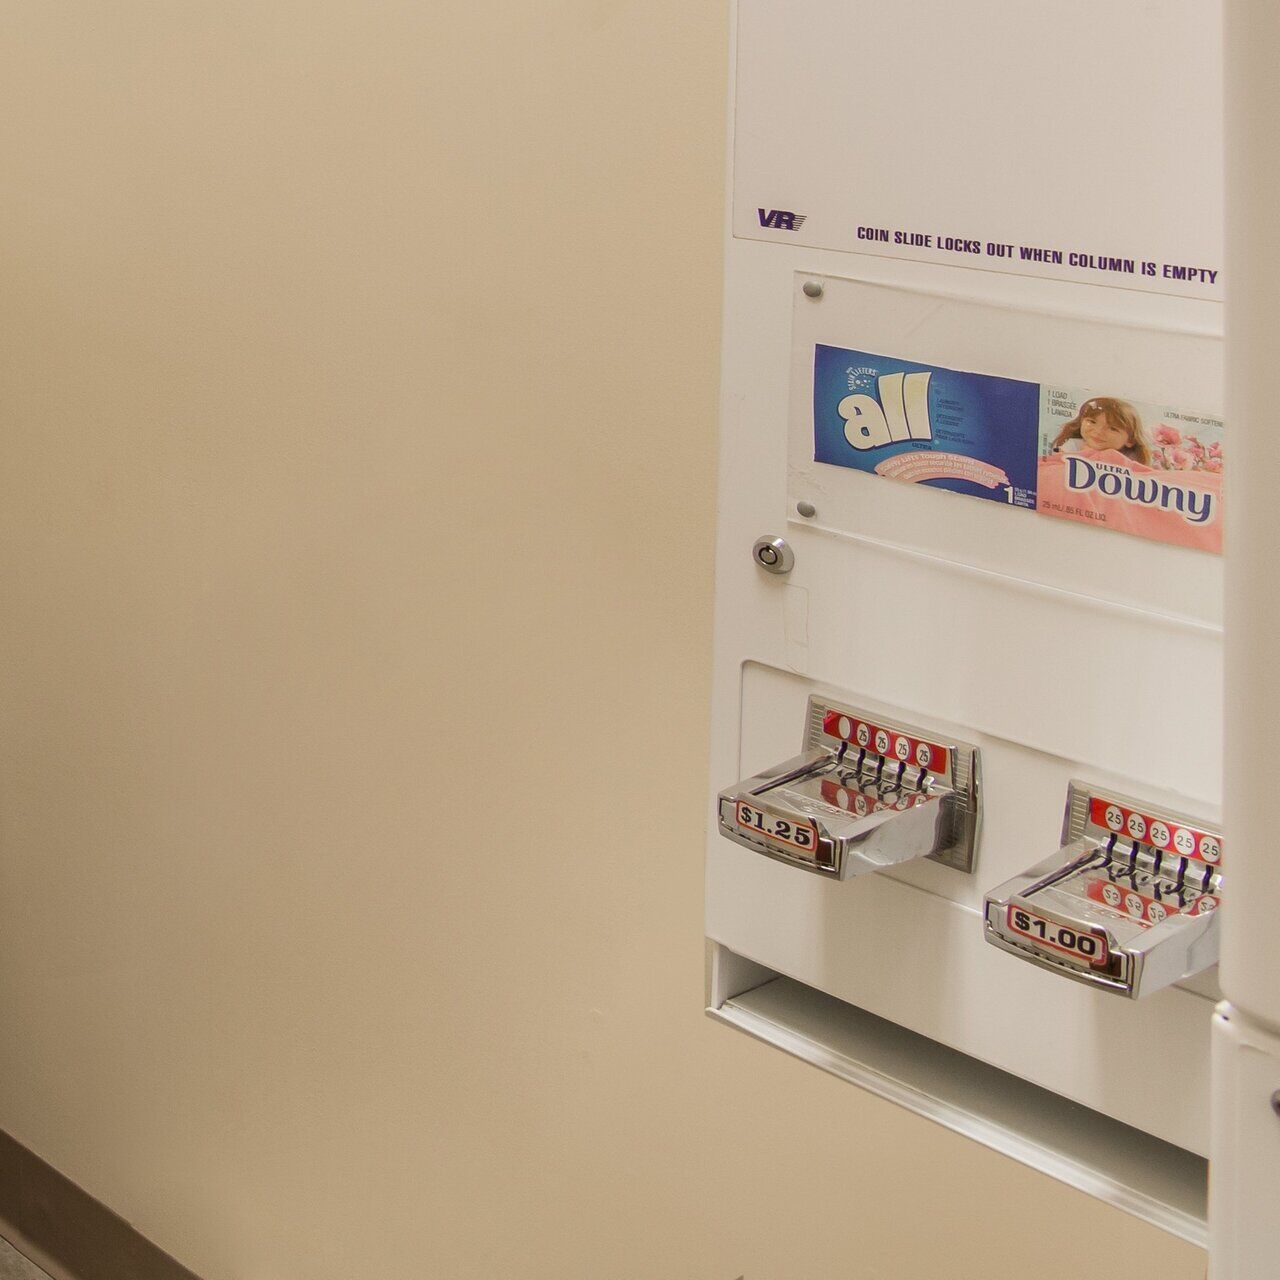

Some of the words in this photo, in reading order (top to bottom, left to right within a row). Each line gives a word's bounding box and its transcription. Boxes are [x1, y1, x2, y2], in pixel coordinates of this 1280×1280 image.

[857, 226, 889, 242] COIN
[894, 230, 932, 248] SLIDE
[937, 235, 981, 255] LOCKS
[986, 242, 1015, 259] OUT
[1019, 246, 1063, 265] WHEN
[1068, 252, 1136, 275] COLUMN
[1141, 262, 1157, 277] IS
[1163, 265, 1219, 285] EMPTY
[837, 371, 932, 451] all
[1052, 390, 1068, 399] LOAD
[1066, 457, 1212, 522] Downy
[1095, 463, 1131, 476] ULTRA
[1003, 486, 1014, 504] 1
[858, 728, 868, 742] 25
[877, 736, 887, 750] 25
[898, 742, 908, 756] 25
[919, 748, 929, 763] 25
[740, 805, 811, 846] $1.25
[1107, 810, 1122, 826] 25
[1129, 818, 1145, 833] 25
[1152, 826, 1168, 842] 25
[1176, 833, 1193, 850] 25
[1202, 841, 1219, 857] 25
[1014, 911, 1097, 956] $1.00
